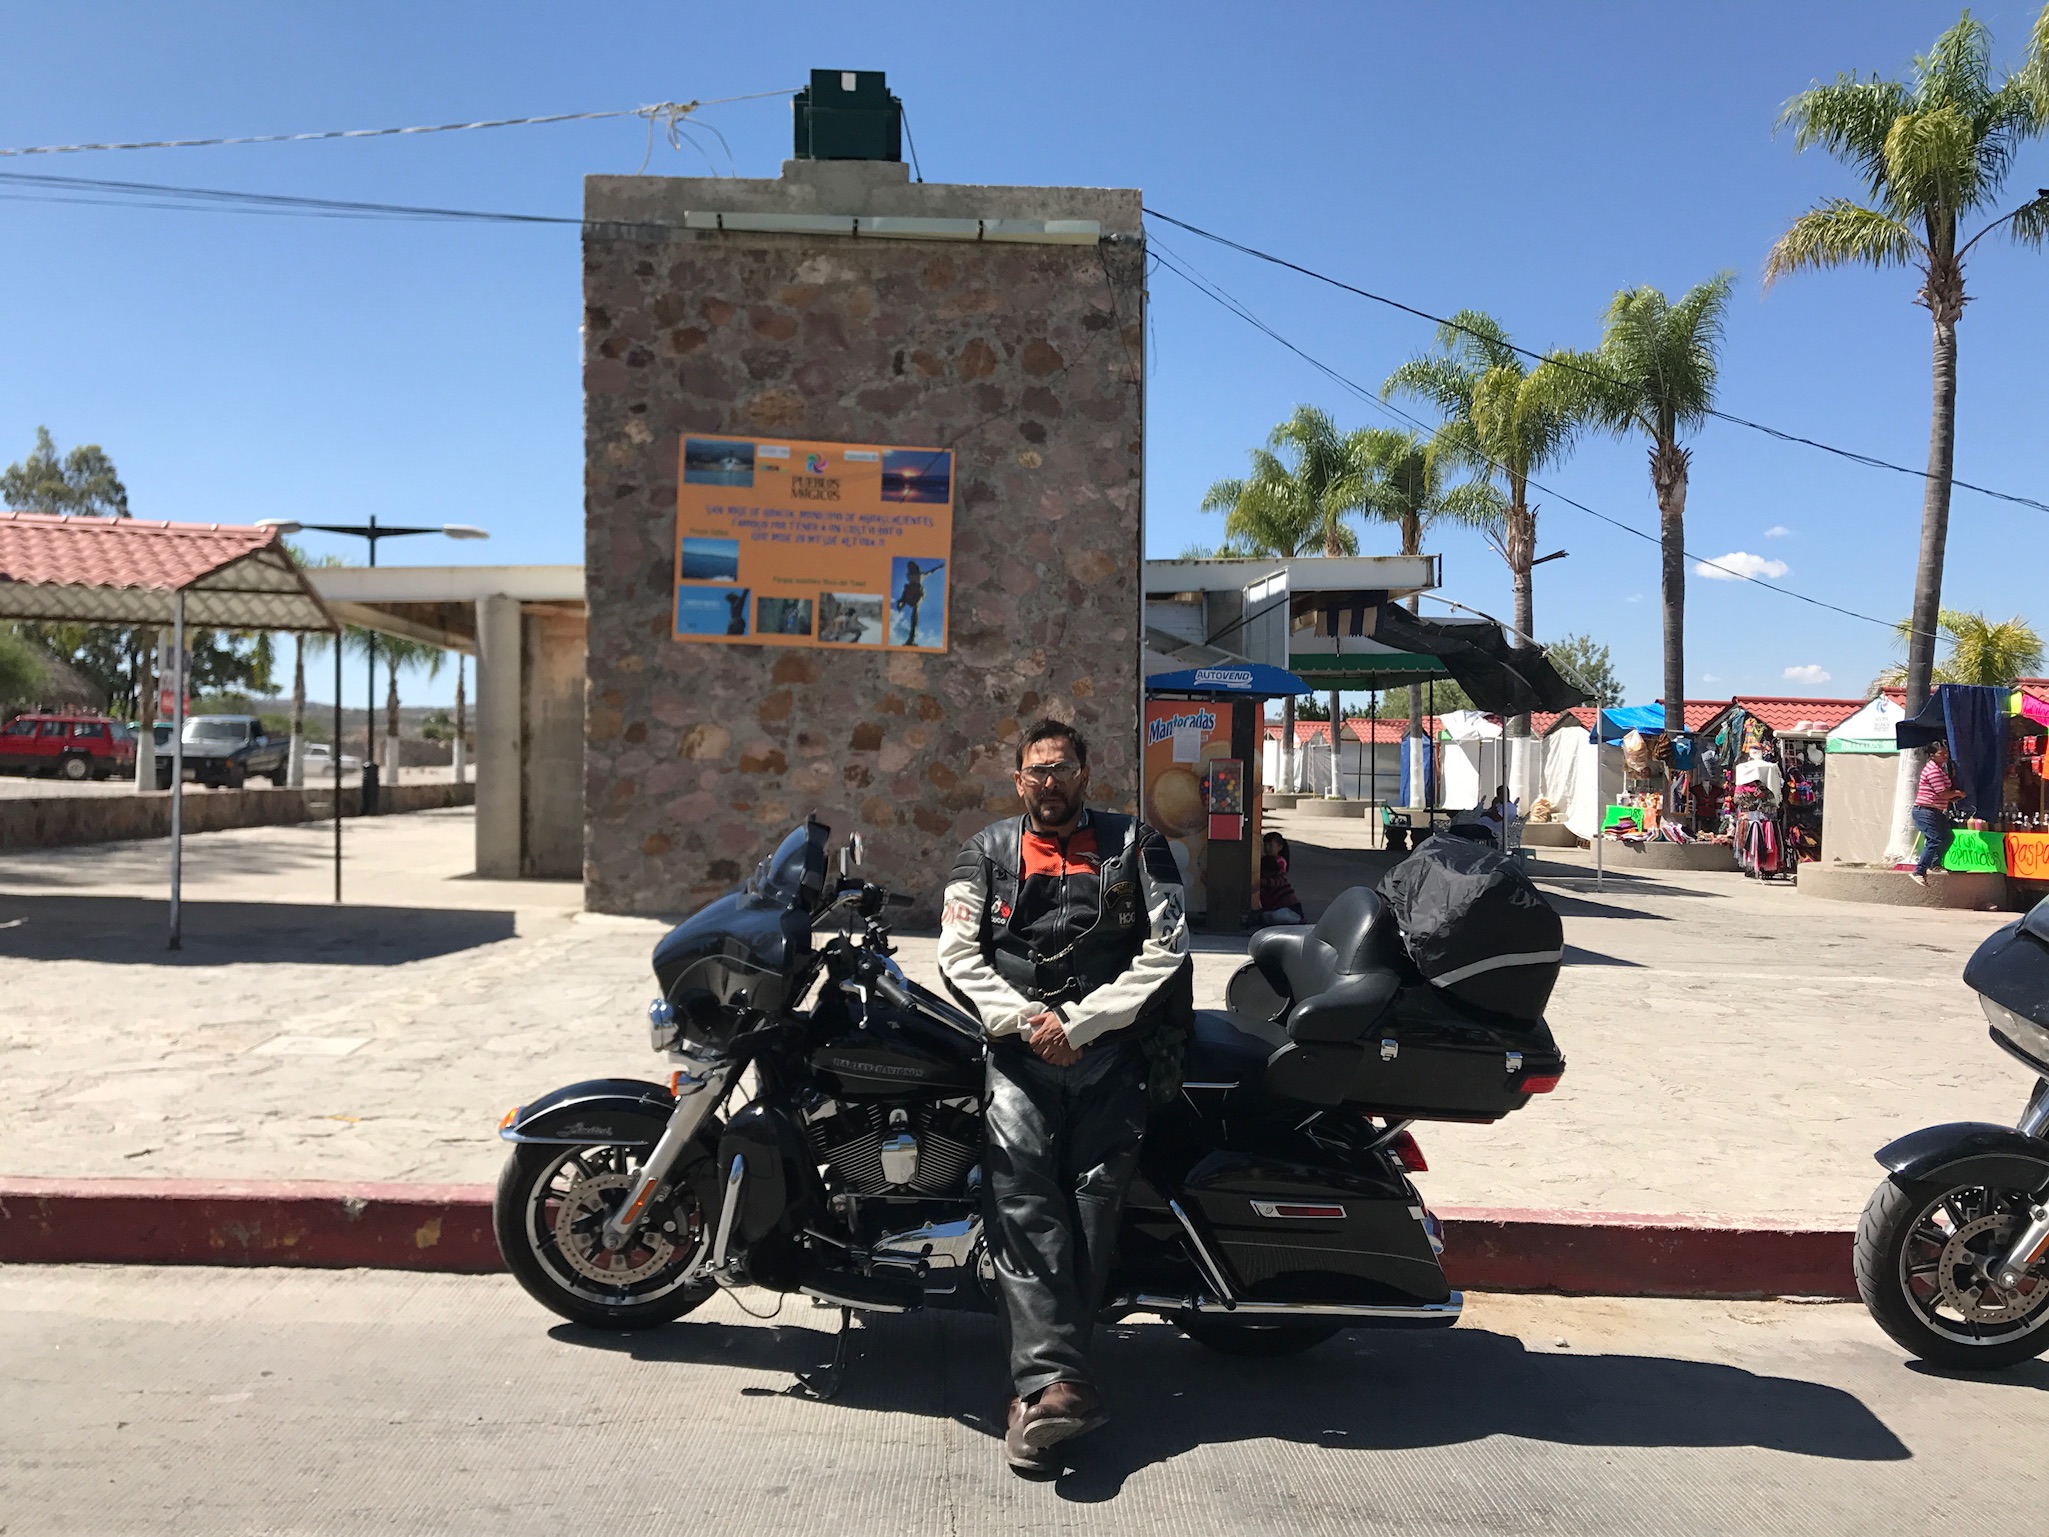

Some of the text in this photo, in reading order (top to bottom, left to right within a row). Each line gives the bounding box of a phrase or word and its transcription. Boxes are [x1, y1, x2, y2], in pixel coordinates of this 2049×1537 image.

[791, 476, 840, 489] PUEBLOS
[1196, 670, 1251, 681] AUTOVEND
[1948, 844, 2002, 869] eparados
